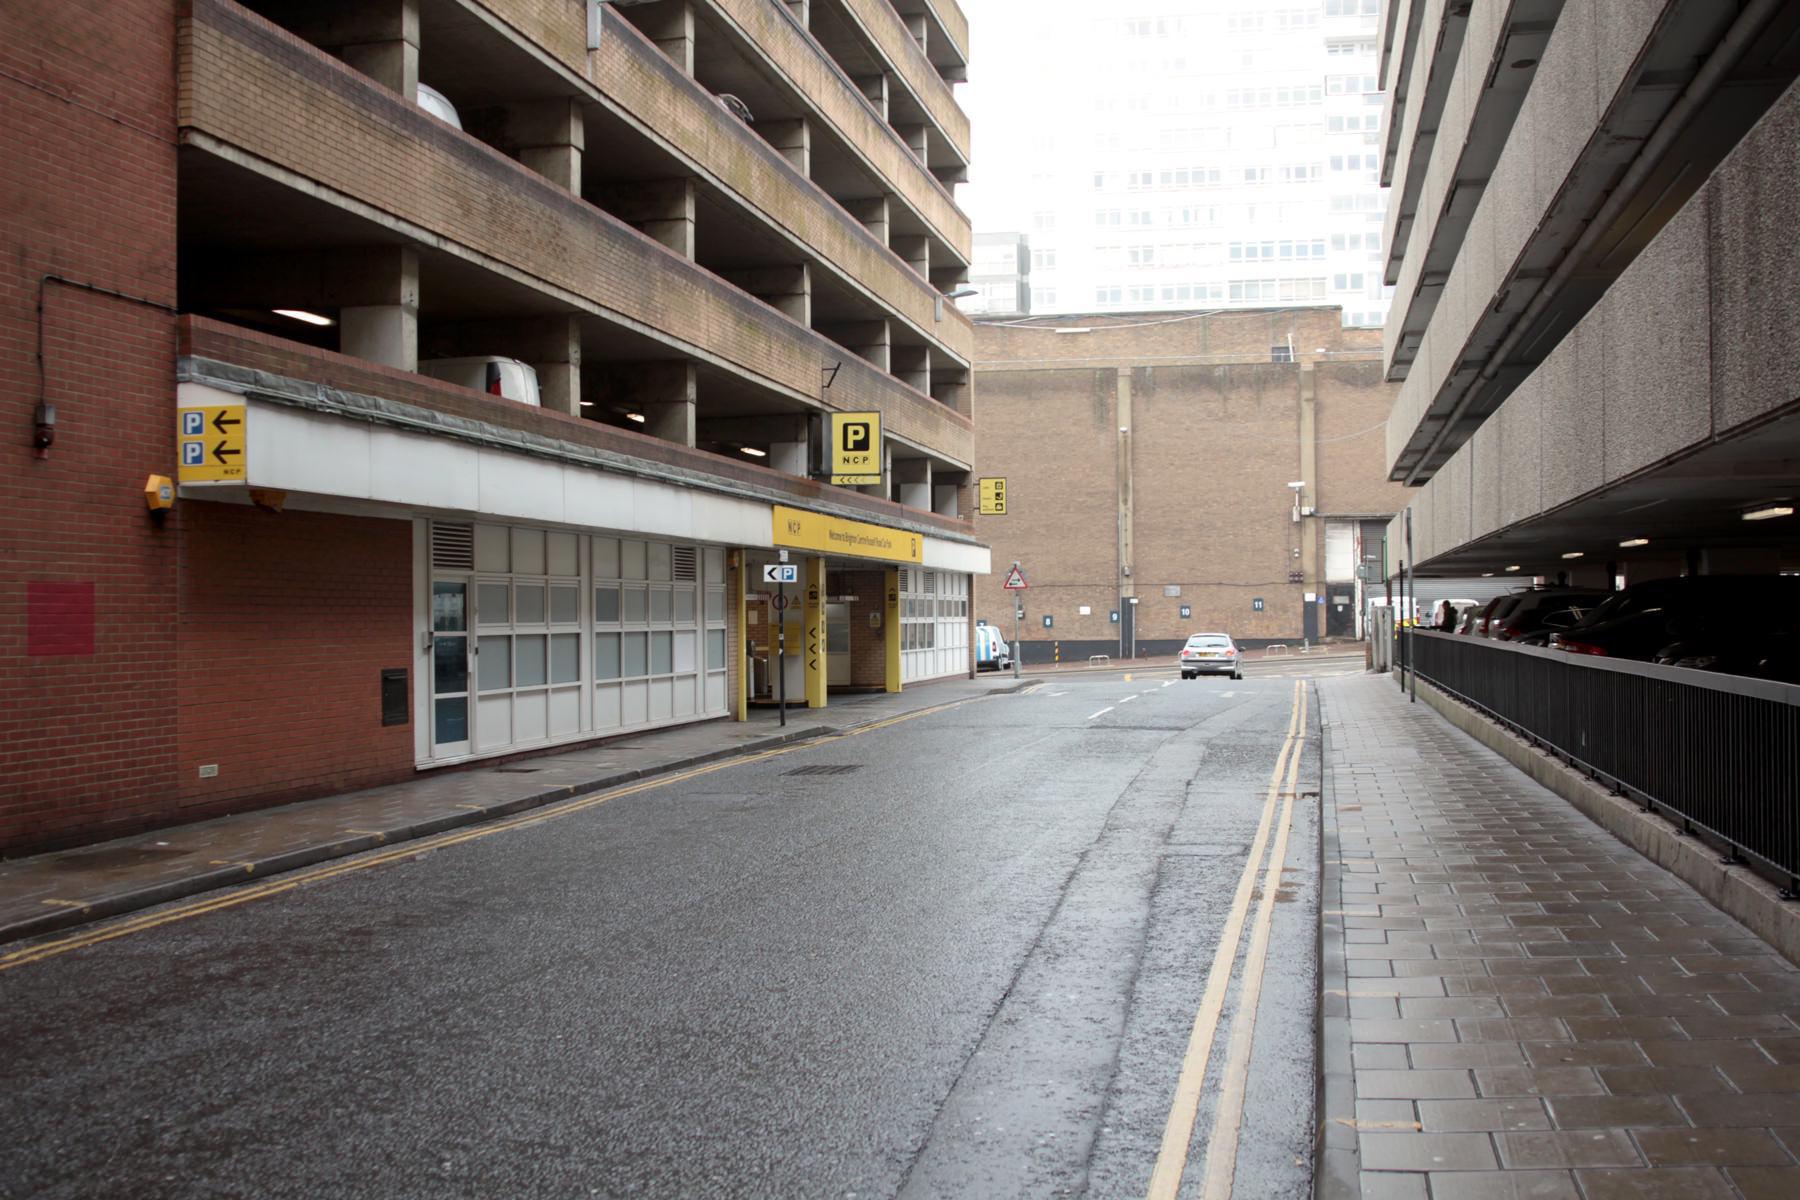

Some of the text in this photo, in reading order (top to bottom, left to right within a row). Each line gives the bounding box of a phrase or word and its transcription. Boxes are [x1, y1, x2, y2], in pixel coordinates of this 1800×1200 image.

[847, 425, 865, 449] P
[843, 456, 869, 464] NCP
[783, 568, 793, 580] P
[1254, 601, 1263, 609] 11
[1181, 608, 1190, 616] 10
